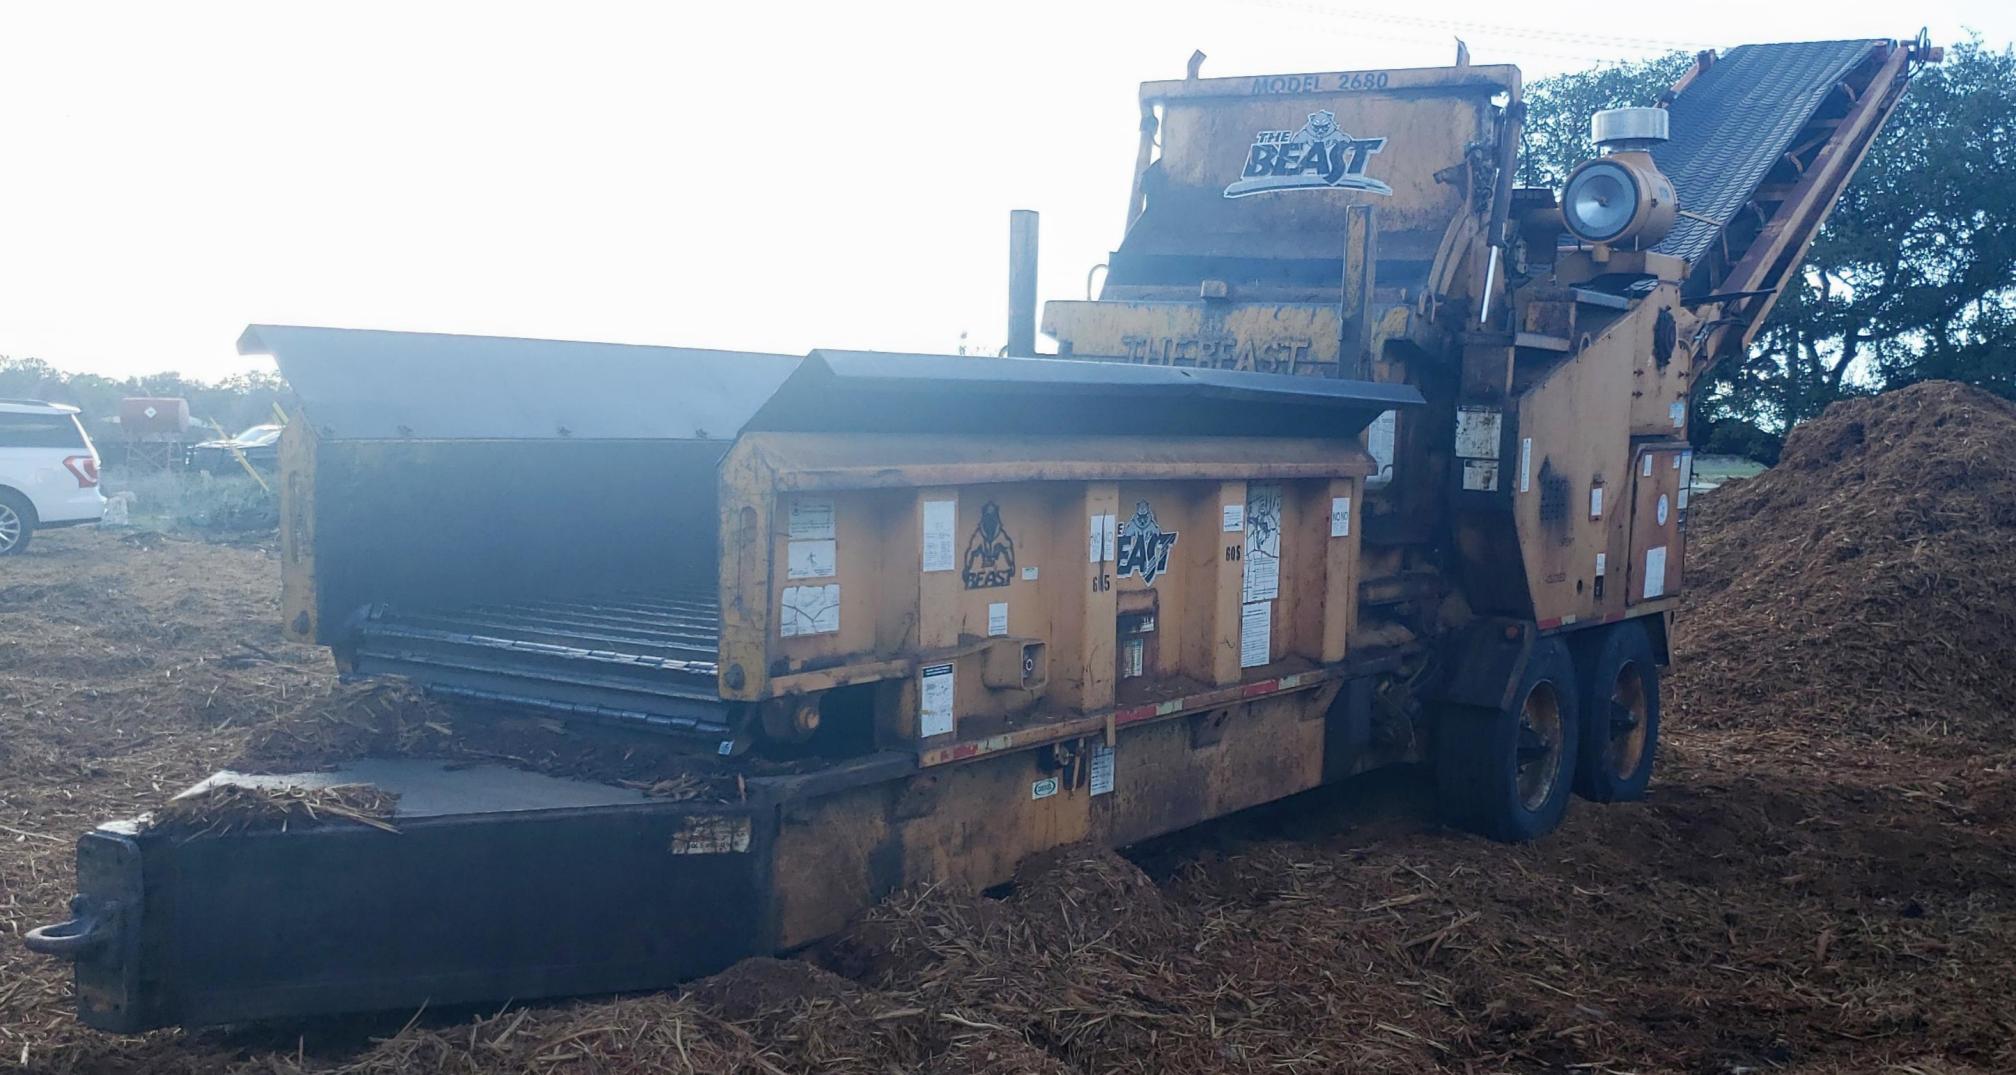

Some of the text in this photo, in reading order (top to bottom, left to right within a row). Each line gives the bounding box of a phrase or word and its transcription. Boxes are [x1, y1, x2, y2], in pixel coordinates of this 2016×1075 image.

[1252, 71, 1389, 95] MODEL 2680
[1257, 131, 1291, 144] THE
[1242, 138, 1384, 185] BEAST
[1116, 532, 1178, 584] EAST
